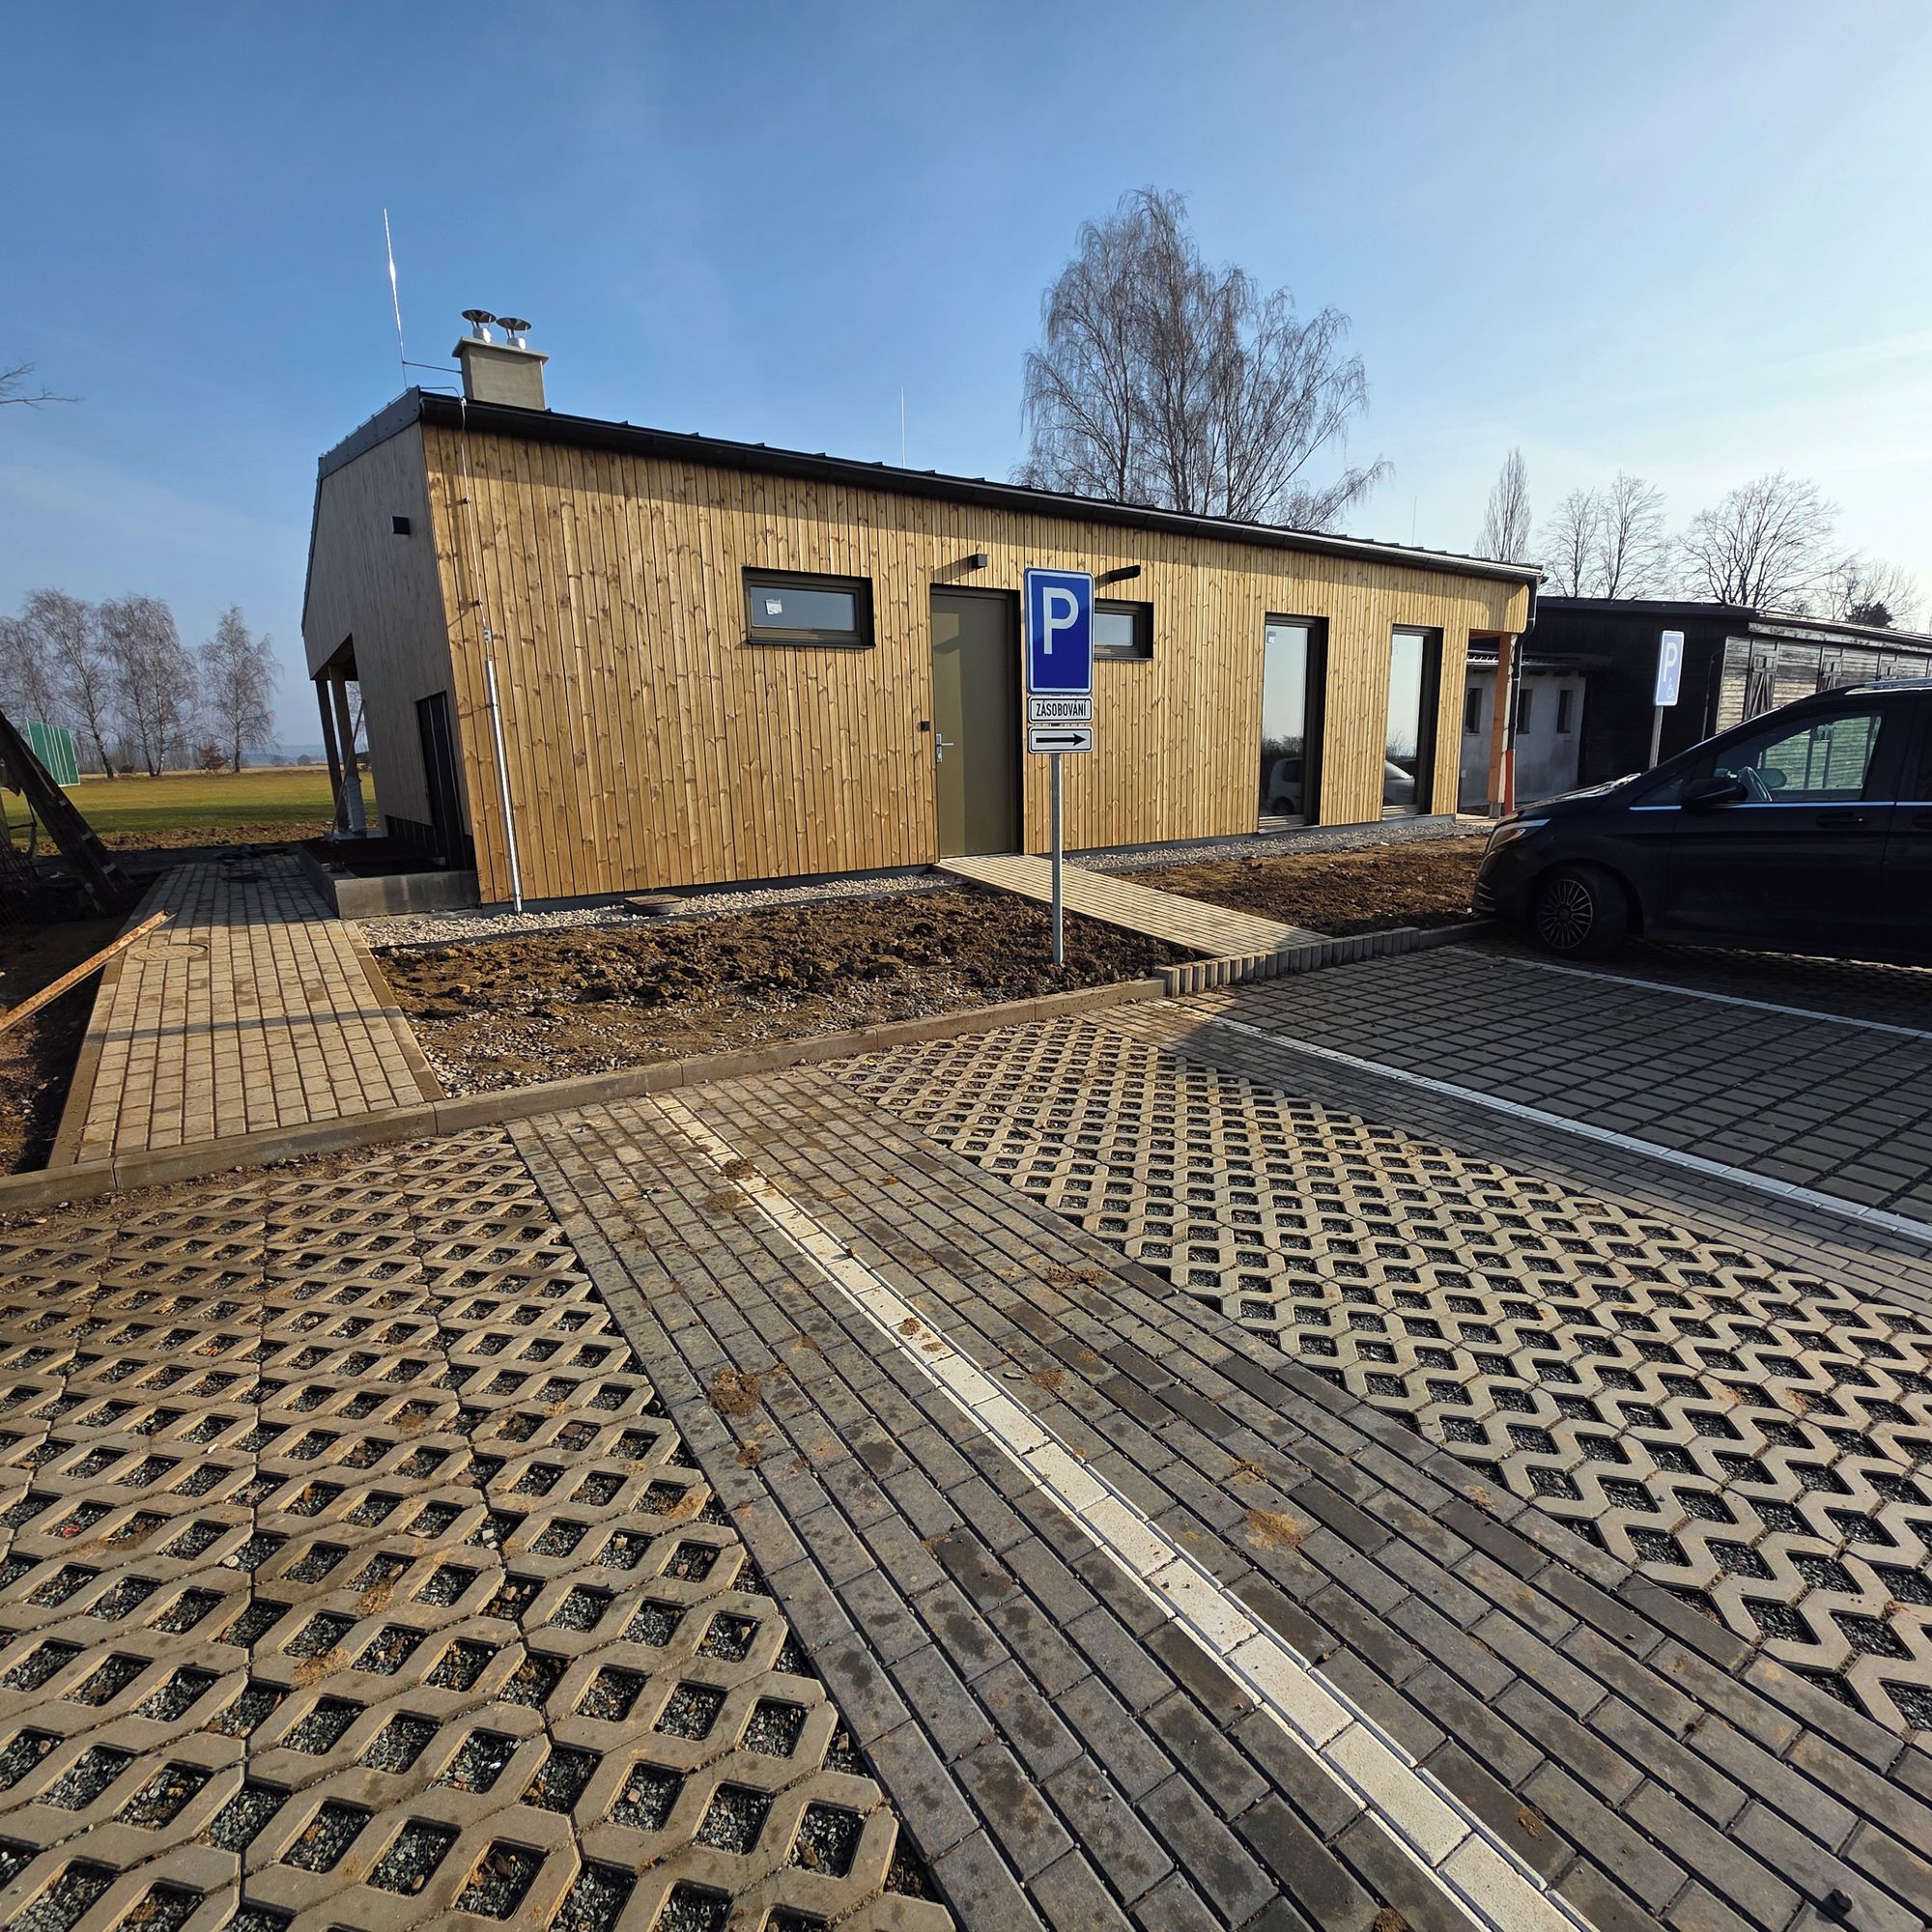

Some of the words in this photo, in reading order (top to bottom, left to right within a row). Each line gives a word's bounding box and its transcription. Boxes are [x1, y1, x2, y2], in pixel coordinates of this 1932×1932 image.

[1042, 586, 1079, 655] P
[1662, 641, 1678, 682] P
[1036, 699, 1087, 717] ZÁSOBOVÁNÍ
